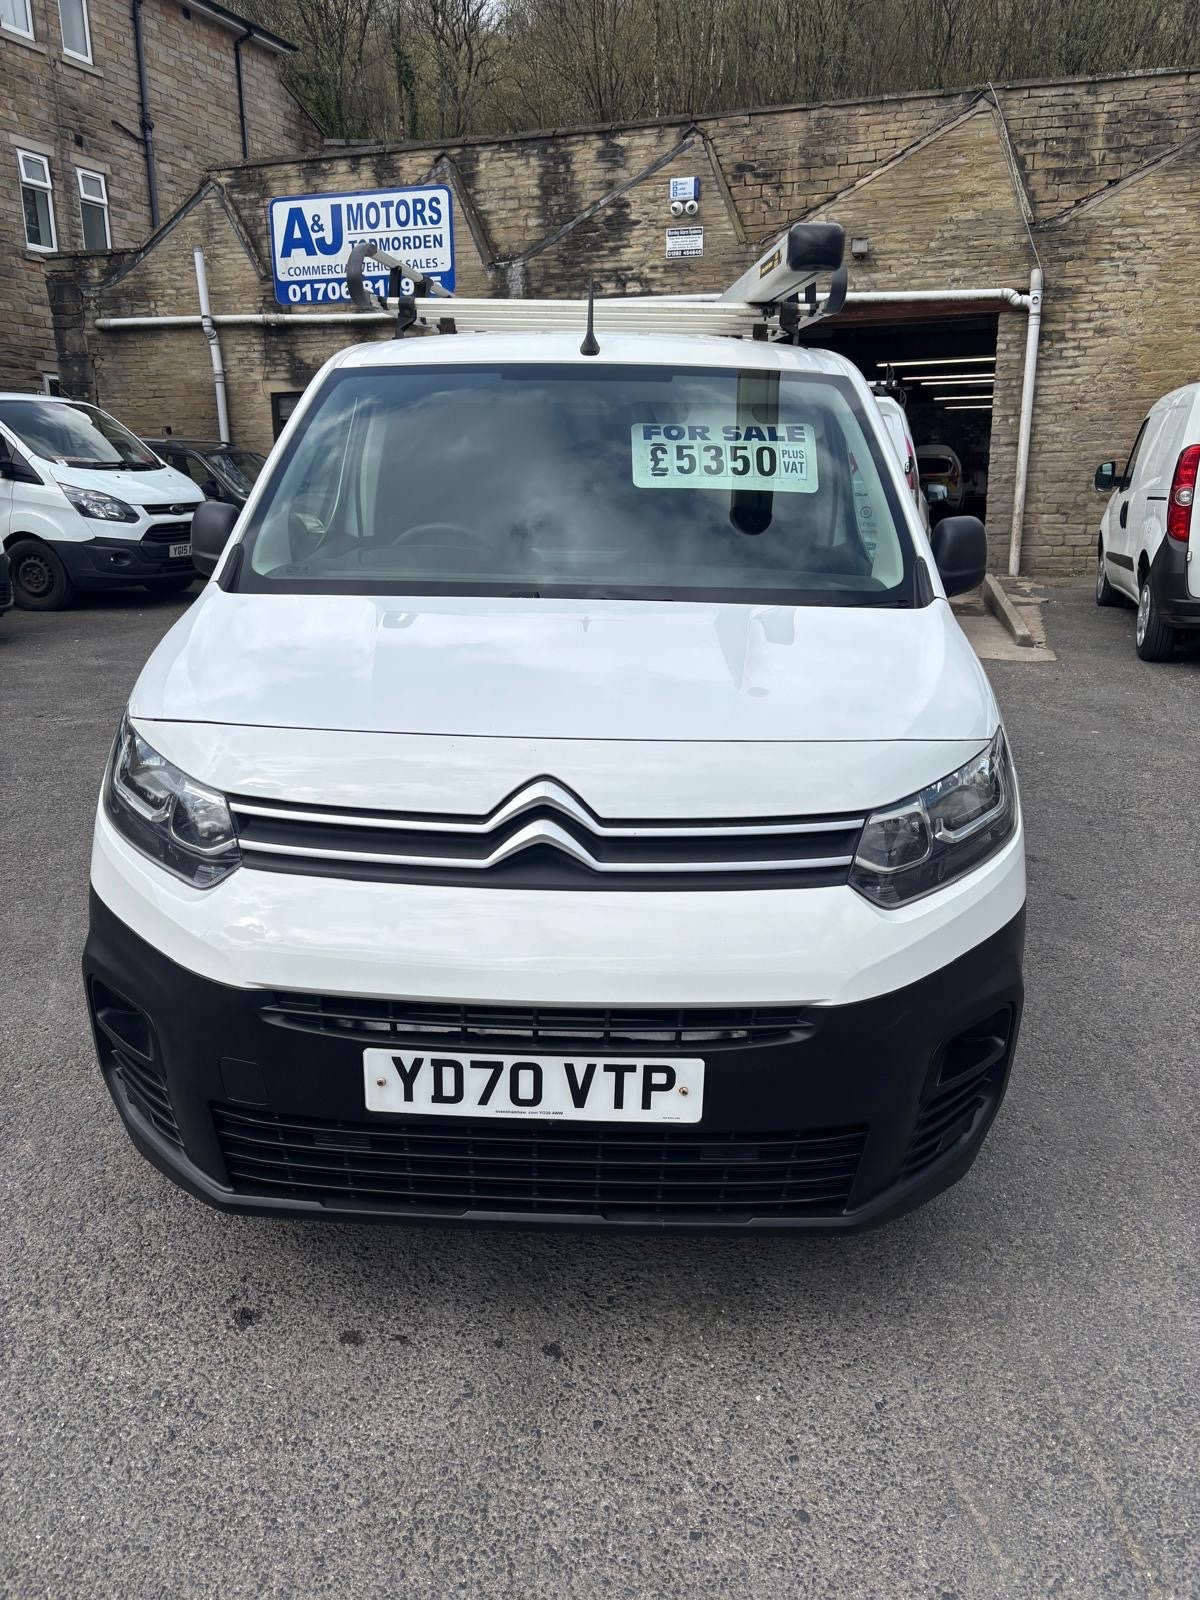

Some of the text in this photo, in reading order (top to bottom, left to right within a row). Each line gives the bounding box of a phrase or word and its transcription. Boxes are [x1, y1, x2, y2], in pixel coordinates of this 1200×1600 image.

[280, 196, 442, 259] A&J MOTORS
[348, 234, 443, 252] TDMORDEN
[406, 257, 438, 269] SALES
[642, 425, 806, 442] FOR SALE
[650, 443, 777, 477] £5350
[781, 449, 805, 460] PLUS
[782, 461, 805, 474] VAT
[391, 1056, 676, 1110] YD70 VTP
